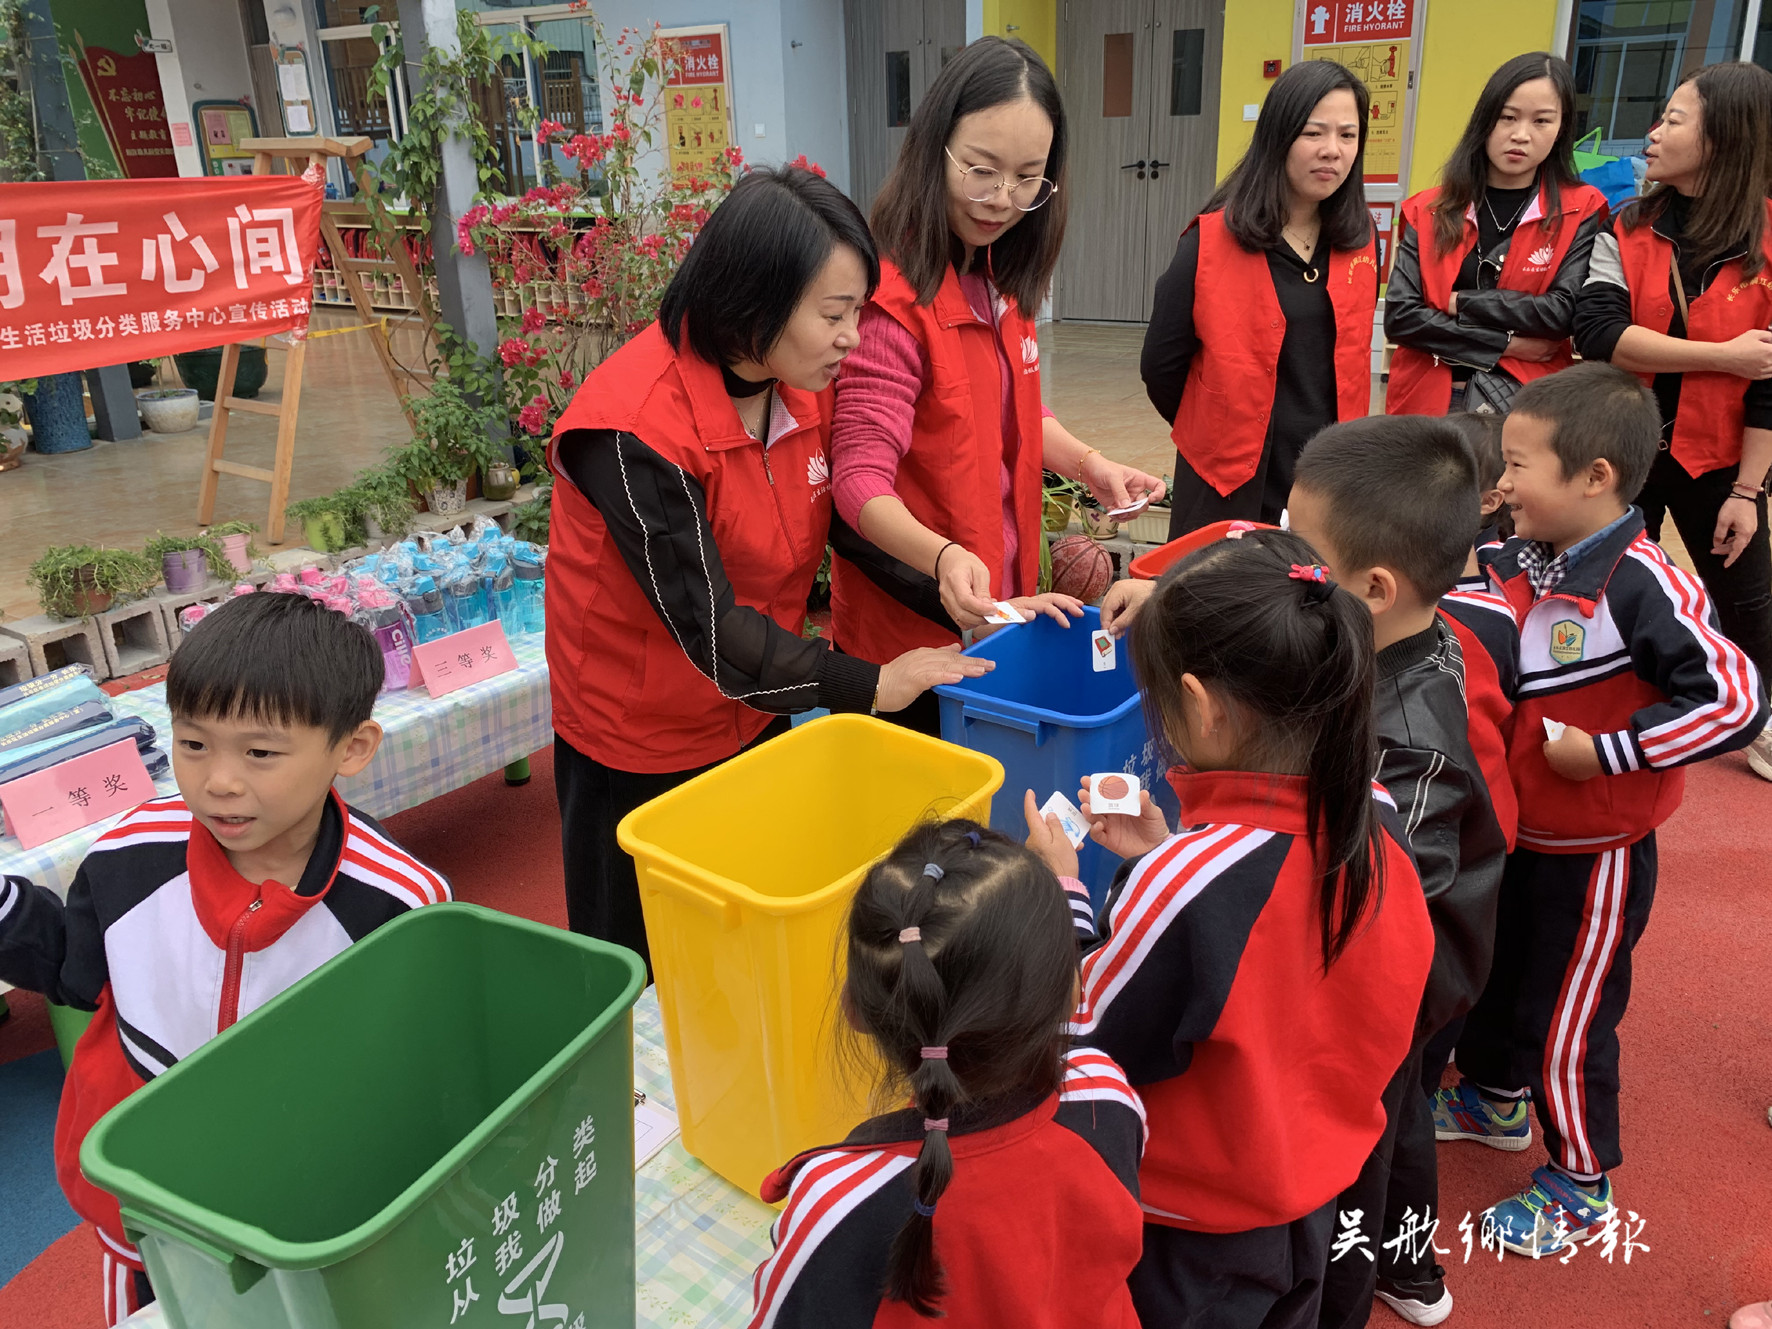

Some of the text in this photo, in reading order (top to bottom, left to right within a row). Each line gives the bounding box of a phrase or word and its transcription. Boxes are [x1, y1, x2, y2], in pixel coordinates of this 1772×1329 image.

[1345, 0, 1406, 23] 消火栓
[1344, 24, 1362, 33] FIRE
[684, 53, 719, 71] 消火栓
[108, 86, 156, 103] 不忘初心
[0, 296, 310, 350] 生活垃圾分类服务中心宣传活动
[434, 645, 498, 678] 三等奖
[31, 773, 129, 818] 一等奖
[450, 1150, 598, 1325] 从我做起
